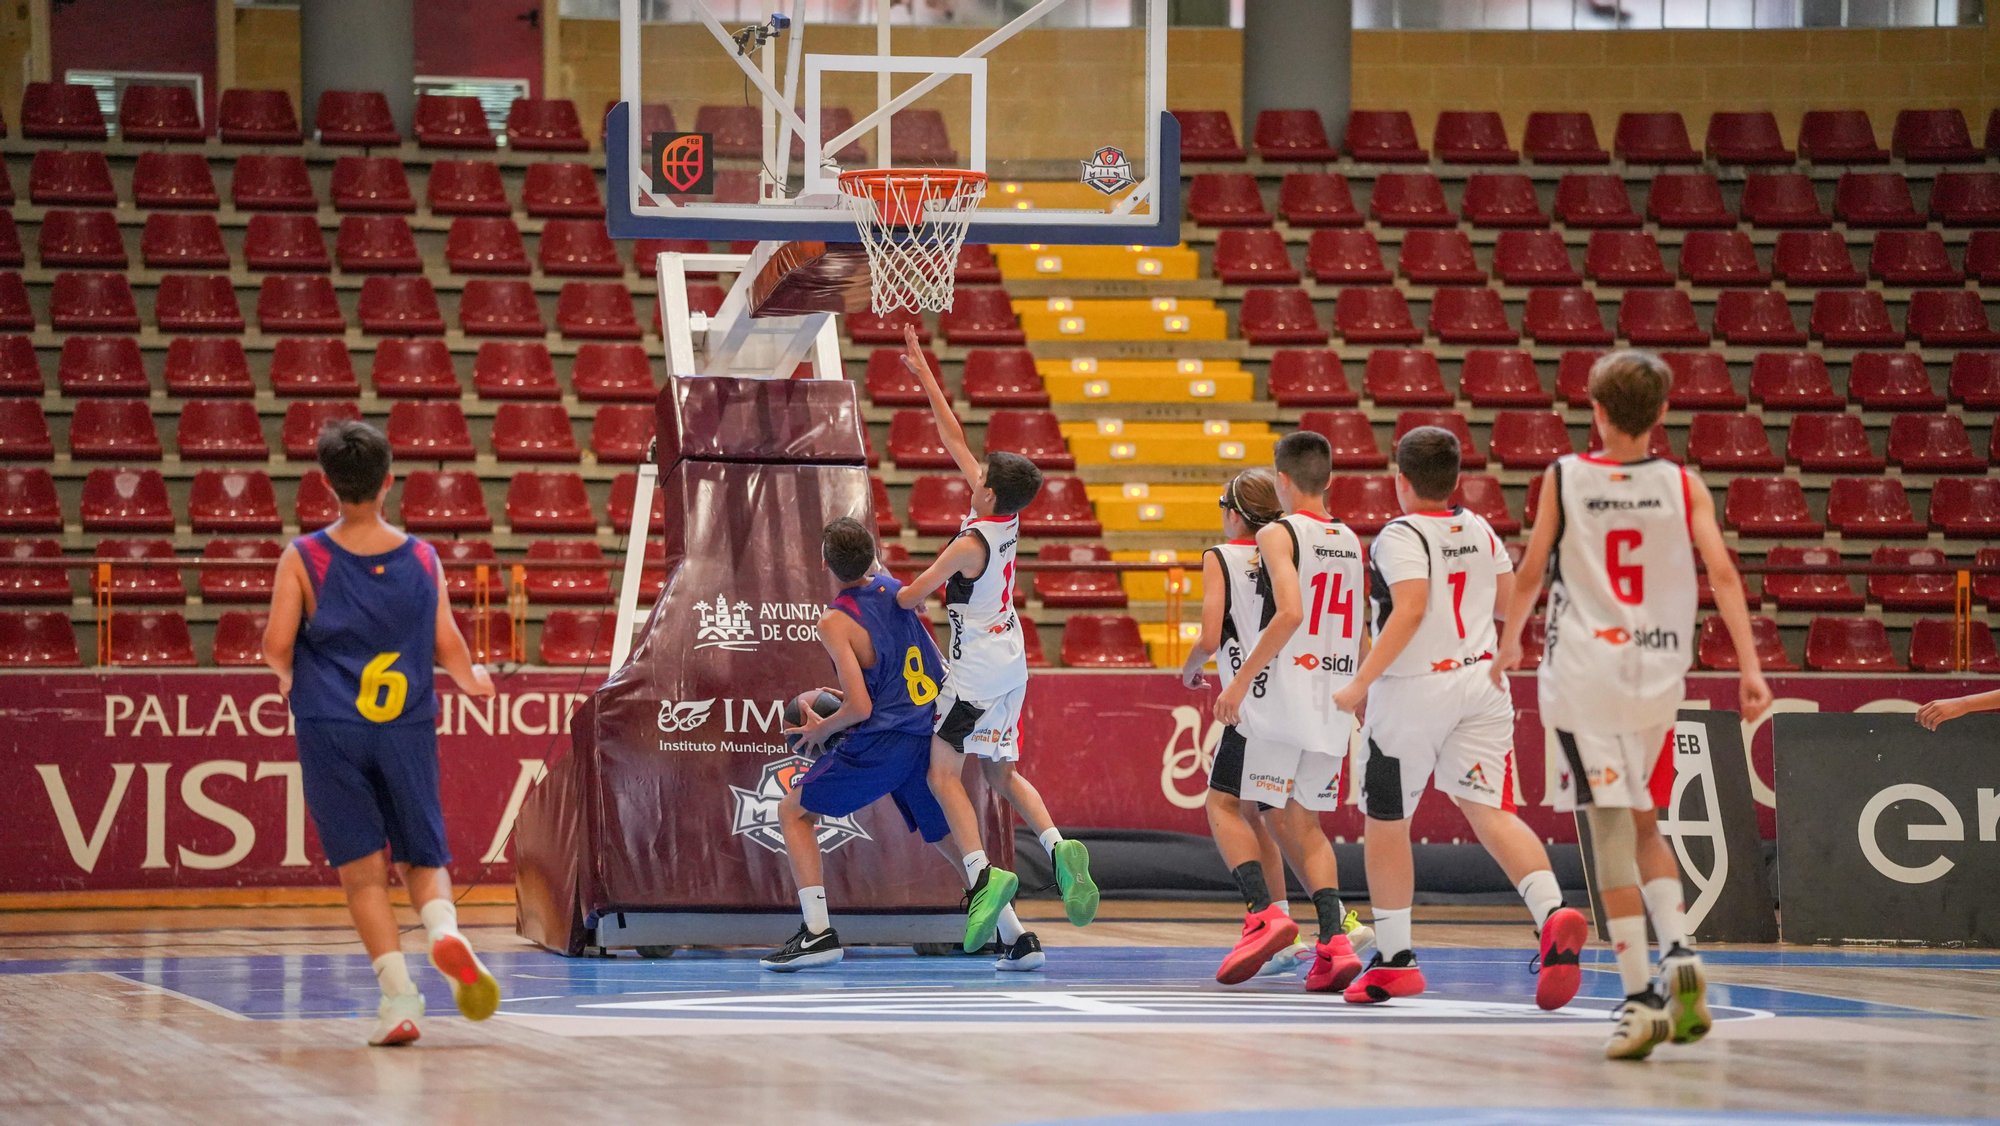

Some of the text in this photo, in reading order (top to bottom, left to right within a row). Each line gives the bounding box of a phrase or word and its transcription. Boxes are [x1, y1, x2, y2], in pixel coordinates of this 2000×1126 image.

[1605, 528, 1644, 606] 6
[759, 602, 829, 621] AYUNTA
[1308, 571, 1354, 639] 14
[760, 623, 783, 641] DE
[355, 651, 409, 723] 6
[902, 645, 939, 706] 8
[723, 698, 784, 733] IM
[659, 739, 788, 756] Instituto Municipal
[1673, 734, 1701, 754] EB
[1249, 773, 1285, 785] Granada
[1256, 780, 1284, 793] Digital
[34, 760, 318, 874] VIST
